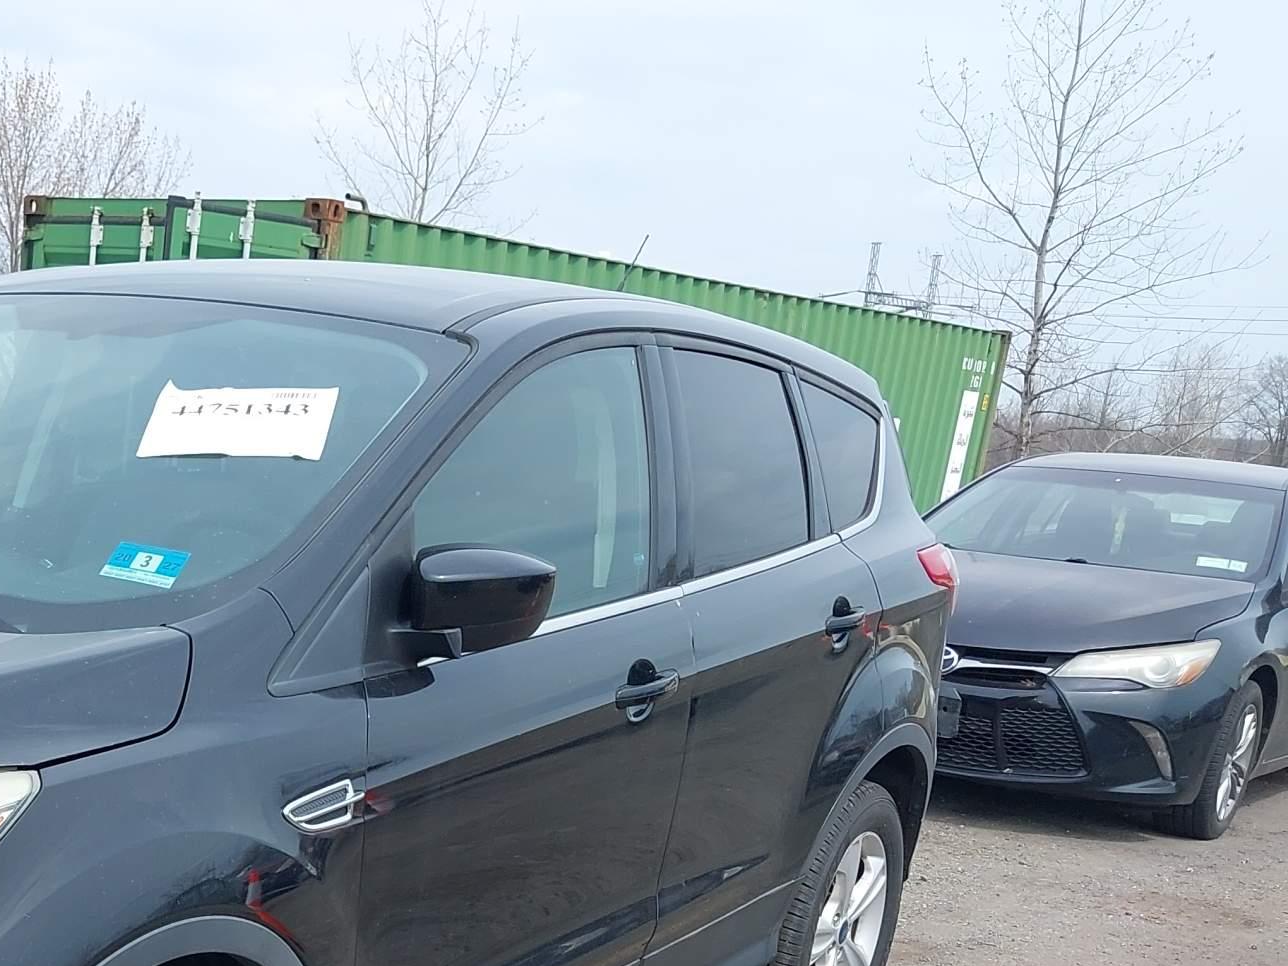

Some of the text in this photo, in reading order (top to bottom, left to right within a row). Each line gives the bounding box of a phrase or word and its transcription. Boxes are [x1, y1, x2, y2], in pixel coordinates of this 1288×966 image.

[172, 403, 310, 416] 44751343
[140, 555, 152, 568] 3
[164, 562, 181, 571] 27
